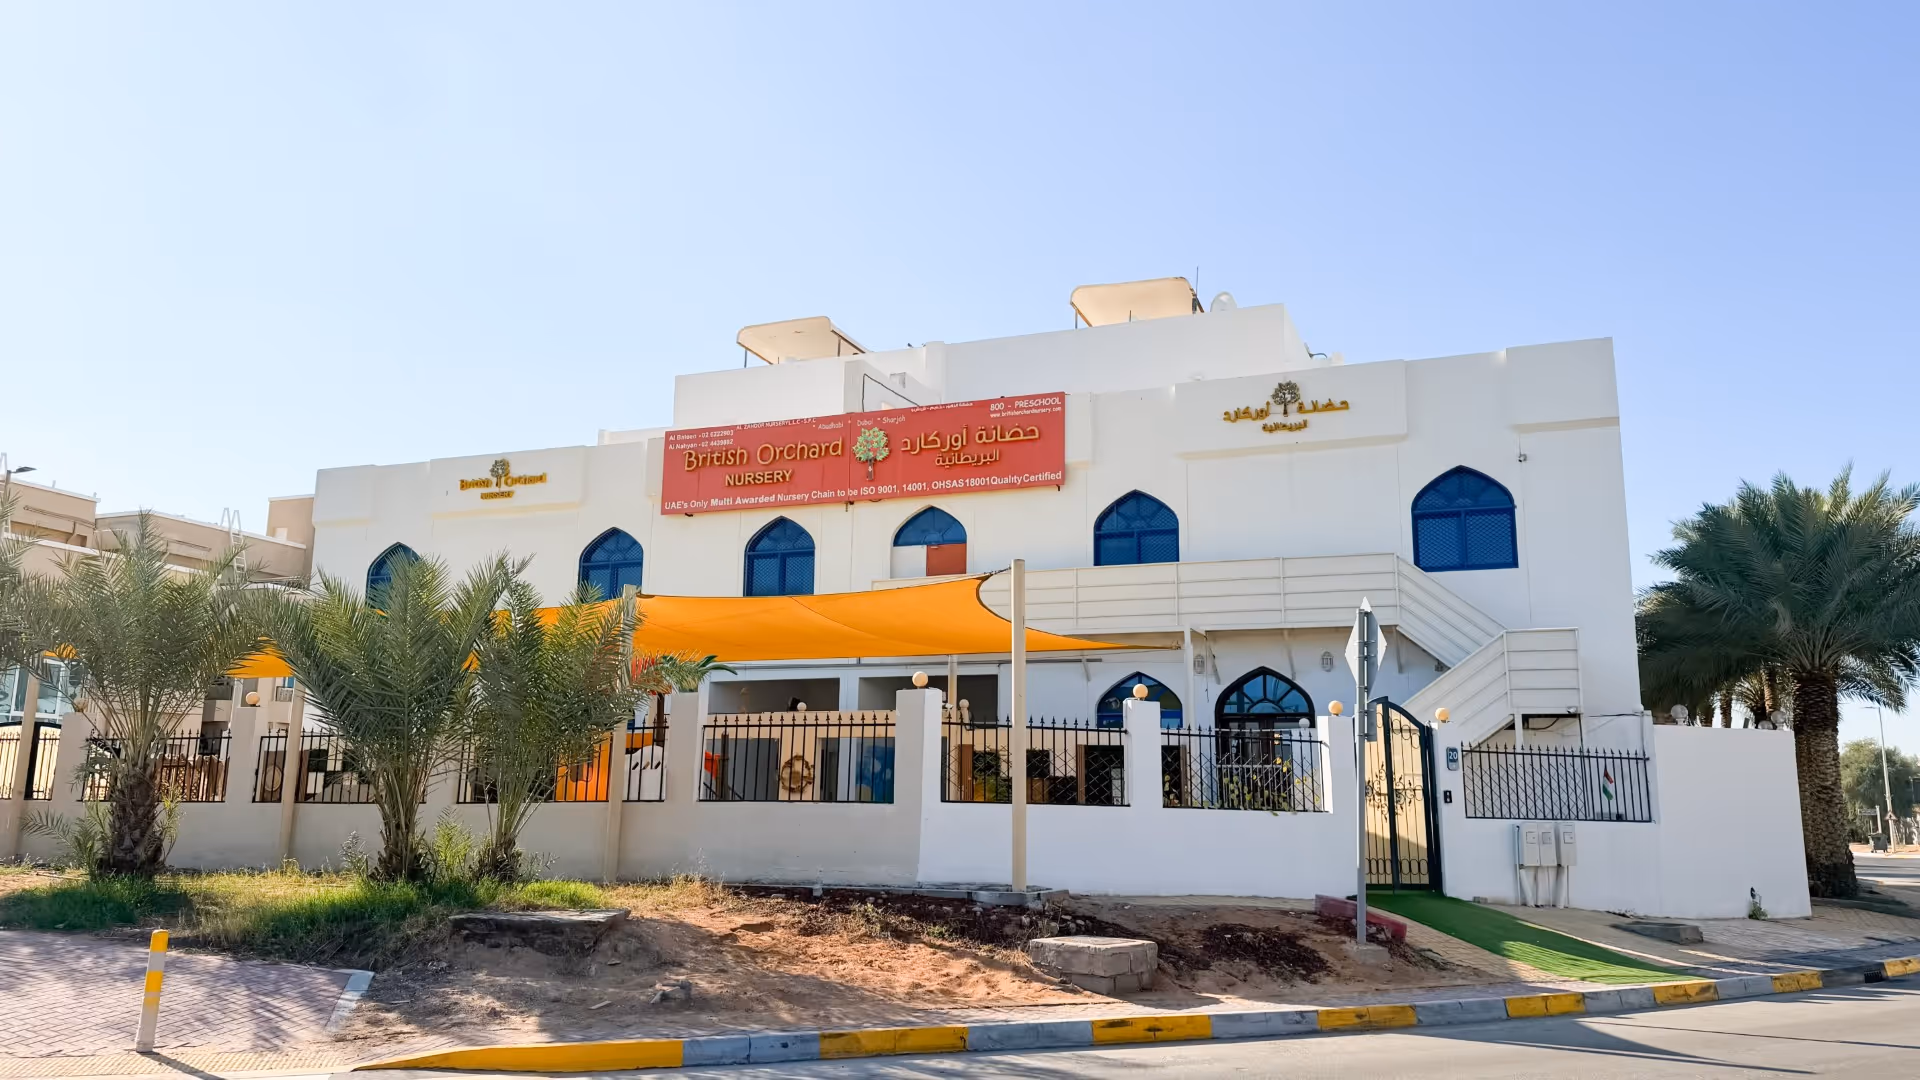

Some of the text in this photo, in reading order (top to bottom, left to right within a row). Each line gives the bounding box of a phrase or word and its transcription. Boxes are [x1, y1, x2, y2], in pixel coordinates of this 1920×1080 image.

[989, 402, 1005, 411] 800
[1014, 396, 1062, 409] PRESCHOOL
[900, 423, 1040, 455] حضانة أوركارد
[683, 437, 843, 472] British Orchard
[934, 449, 1000, 468] البريطانية
[725, 469, 793, 487] NURSERY
[664, 470, 1062, 510] UAE's Only Multi Awarded Nursery Chain to be ISO 9001, 14001, OHSAS 18001 Quality Certified
[1448, 751, 1458, 760] 20
